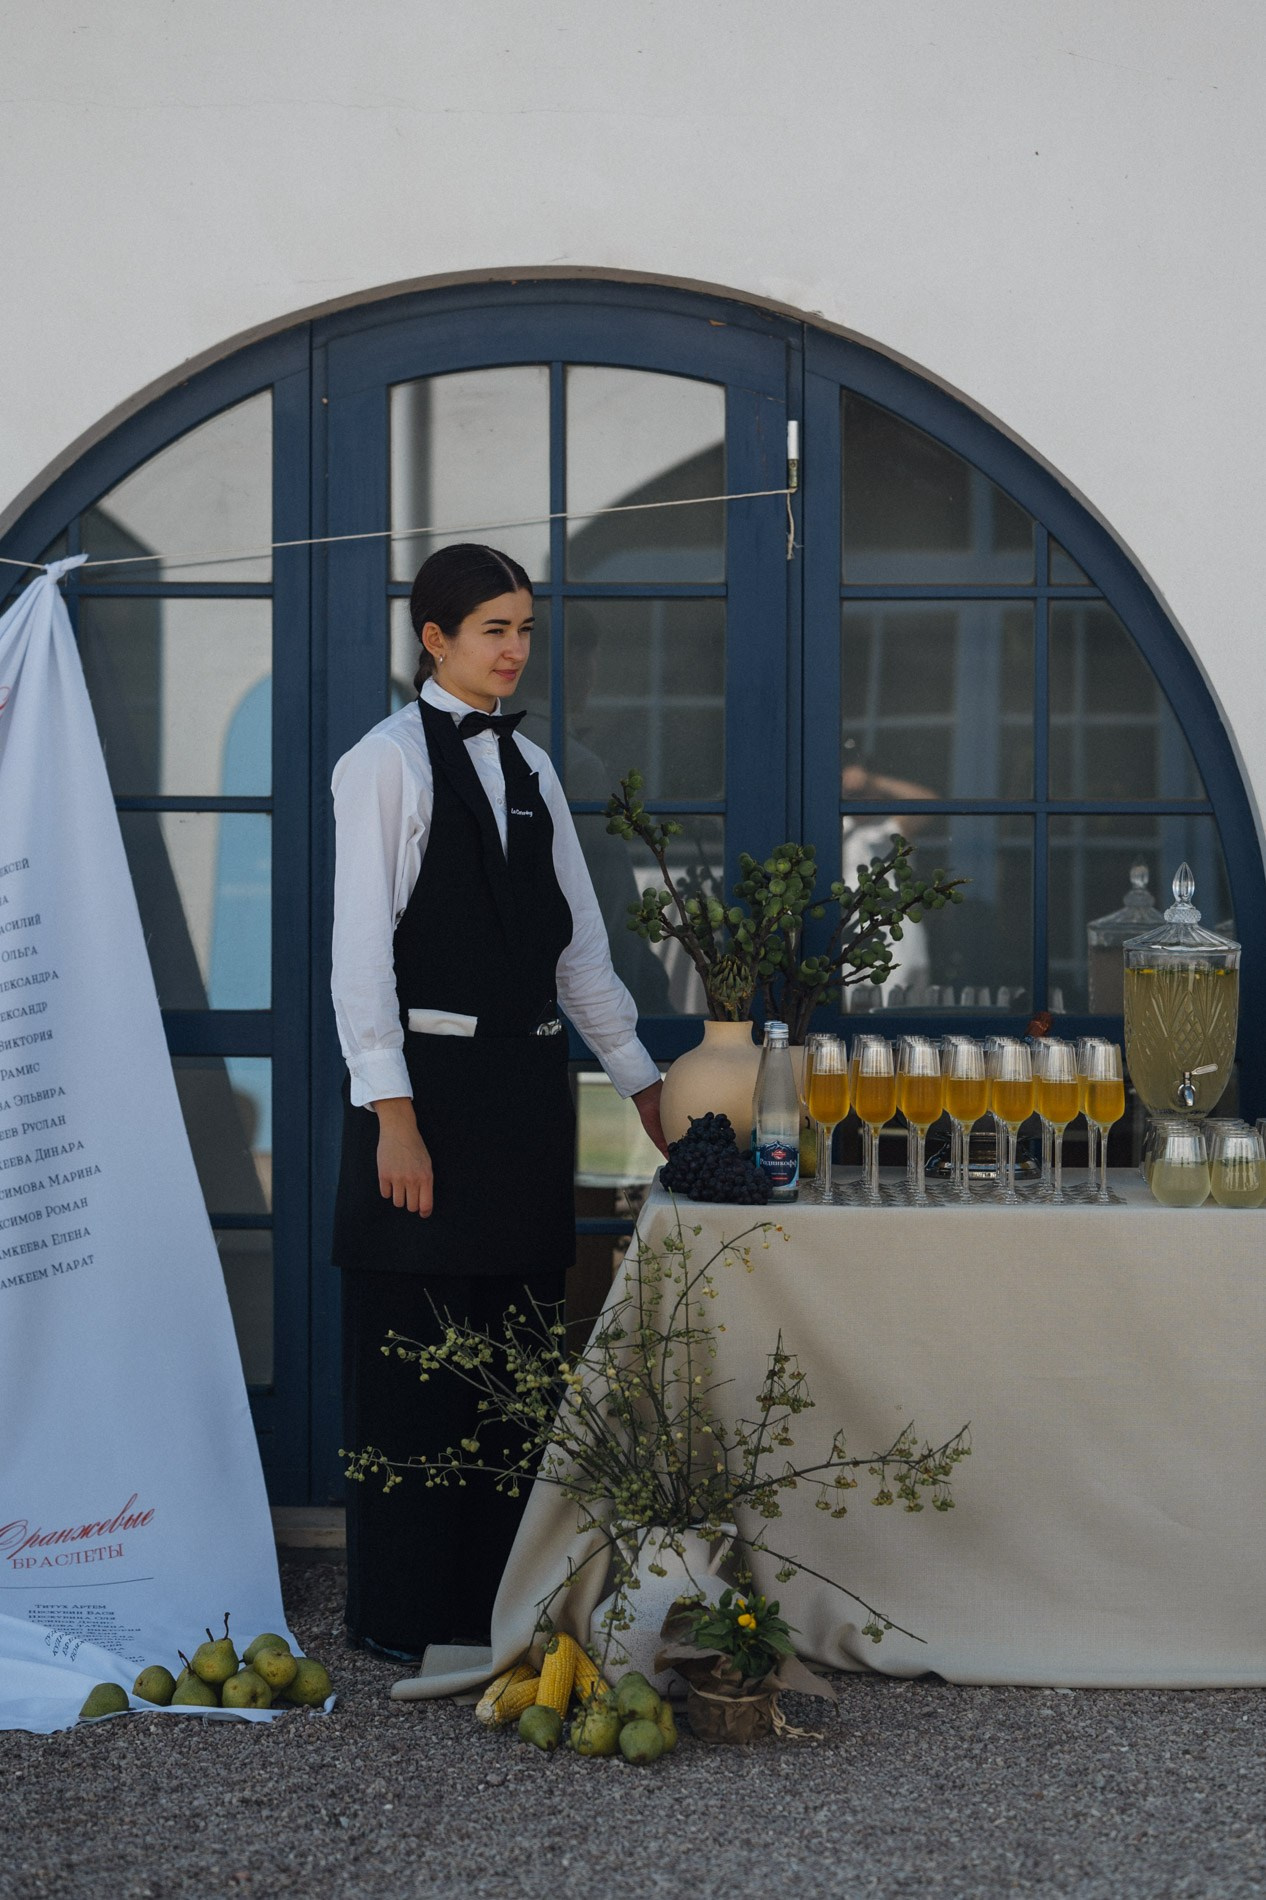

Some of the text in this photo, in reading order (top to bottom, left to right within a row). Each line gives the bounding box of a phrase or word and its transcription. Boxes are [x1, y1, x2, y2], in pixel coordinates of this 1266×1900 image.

[0, 1062, 41, 1081] РАМИС
[34, 1140, 85, 1163] ДИНАРА
[0, 1239, 49, 1260] МКЕЕВА
[0, 1492, 156, 1560] Оранжевые
[12, 1543, 125, 1569] БРАСЛЕТЫ
